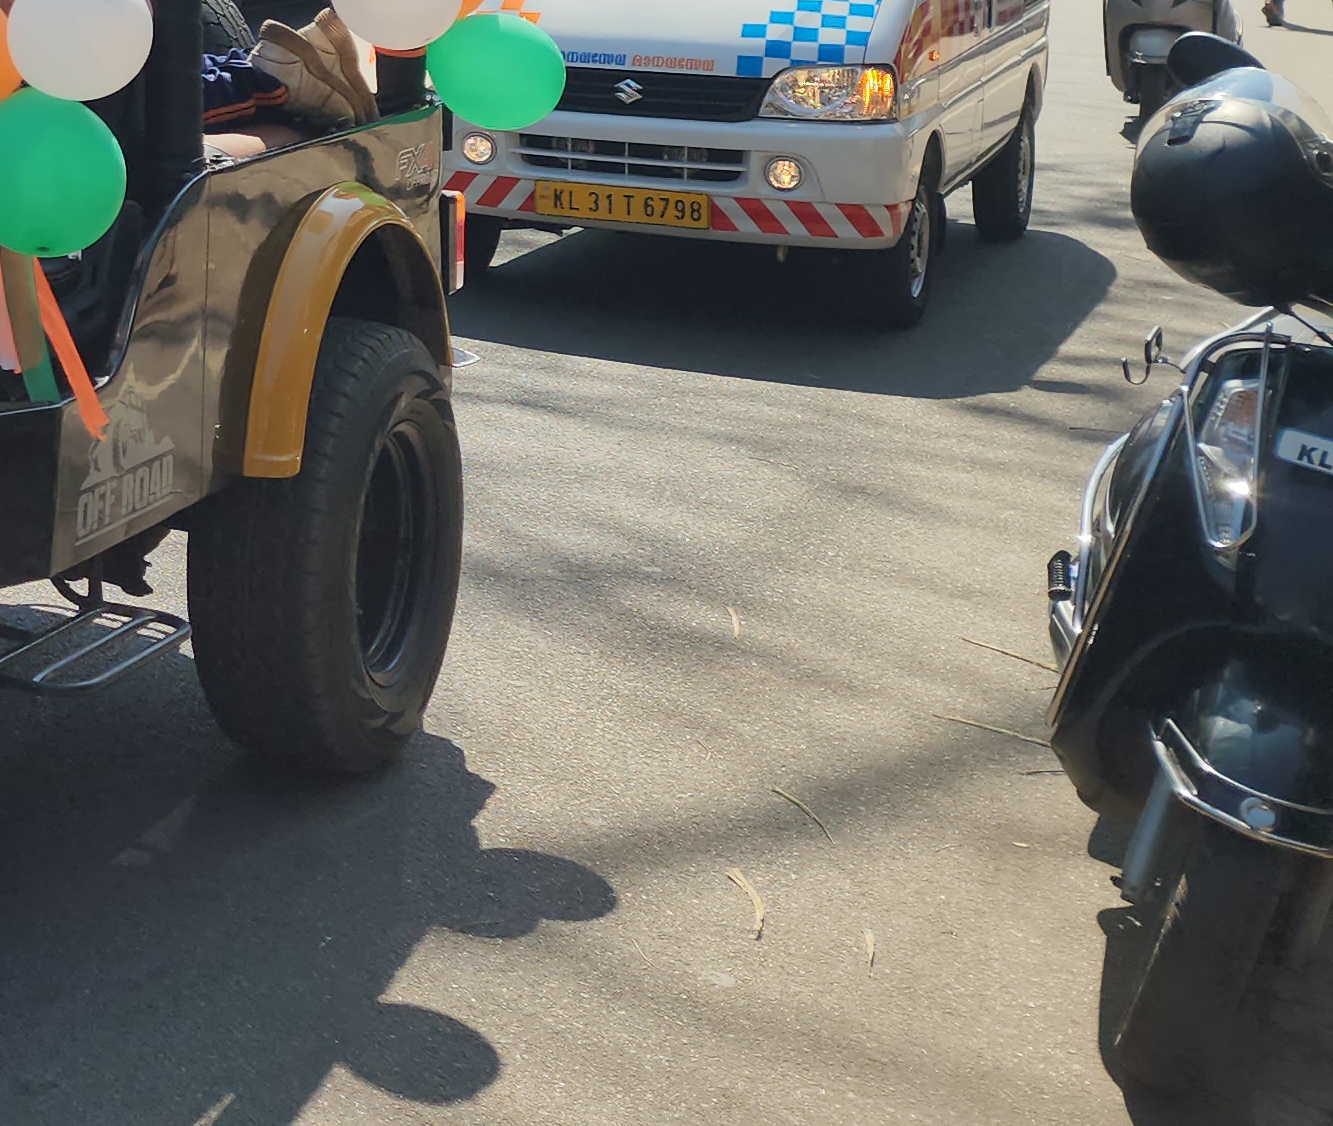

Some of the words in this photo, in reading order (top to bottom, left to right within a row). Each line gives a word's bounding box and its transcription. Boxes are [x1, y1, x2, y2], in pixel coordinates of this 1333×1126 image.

[553, 188, 580, 211] KL
[588, 191, 613, 214] 31
[623, 194, 635, 216] T
[643, 196, 702, 222] 6798
[1297, 443, 1332, 470] KL
[76, 478, 118, 537] OFF
[120, 454, 174, 515] ROAD
